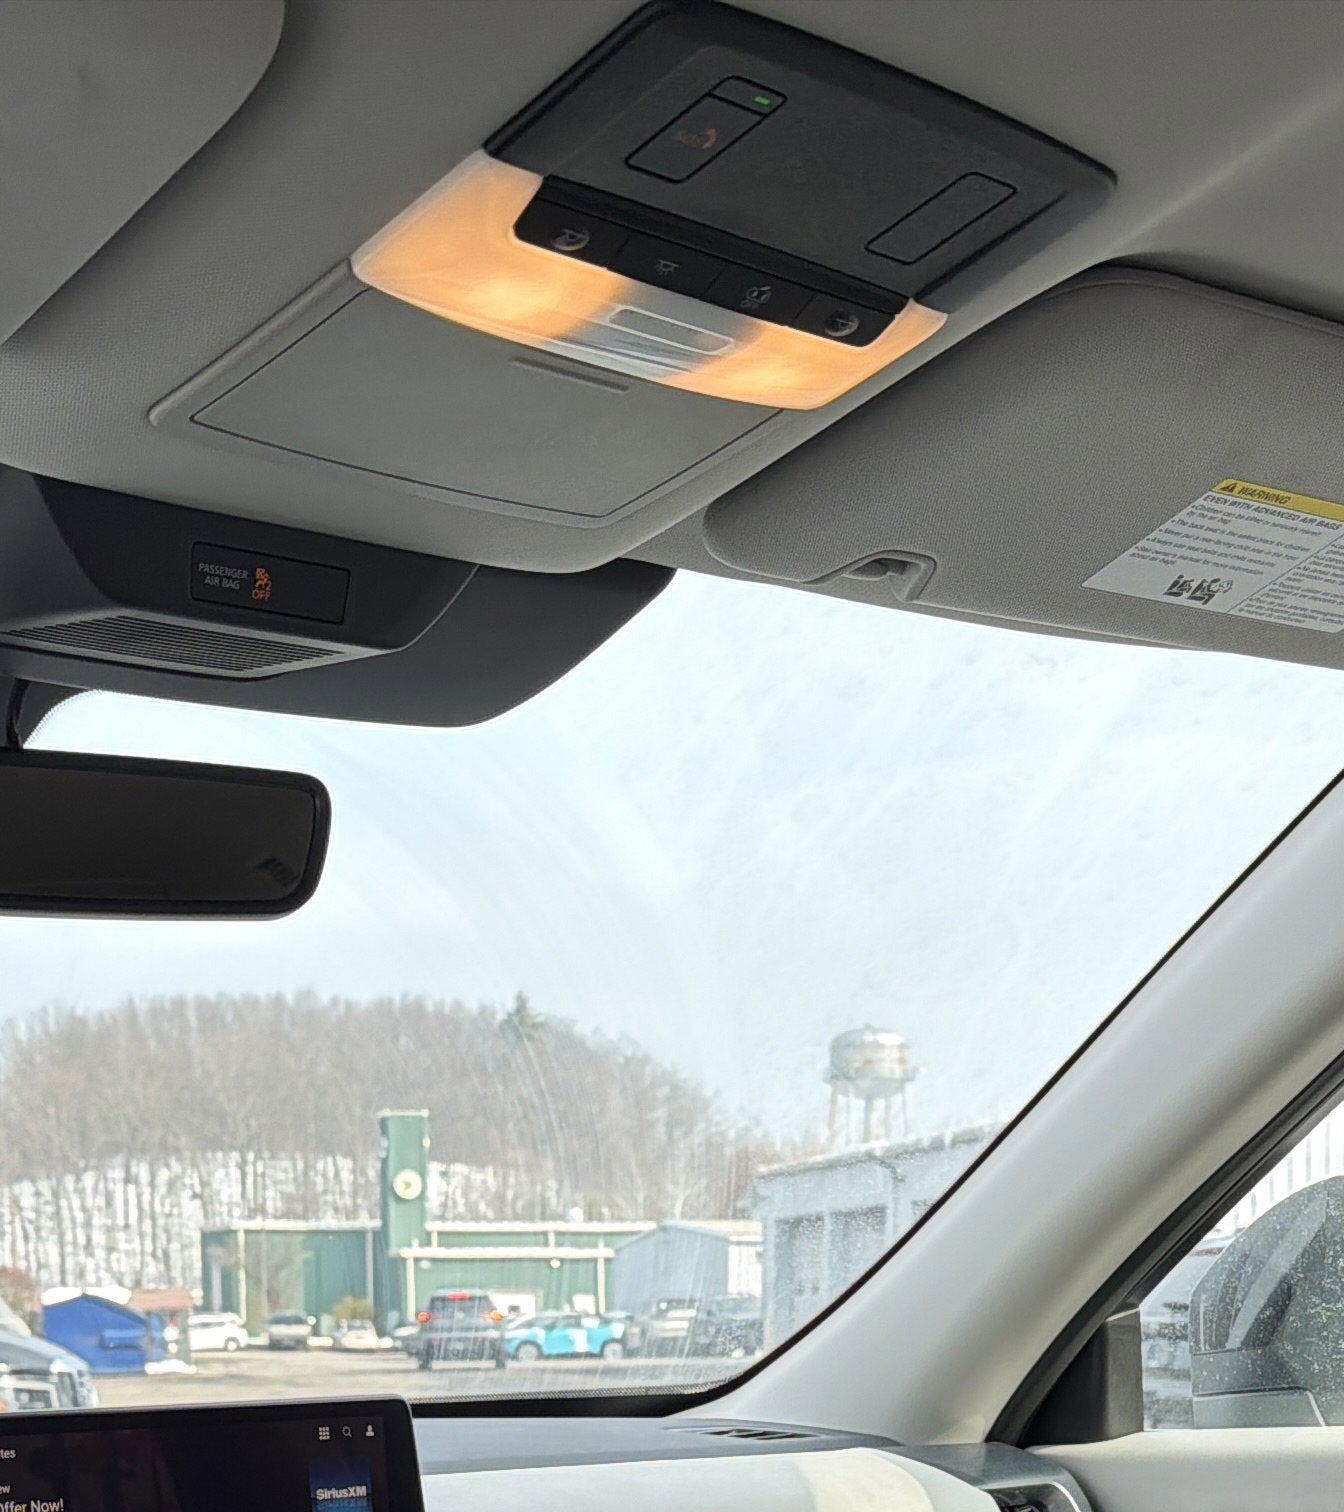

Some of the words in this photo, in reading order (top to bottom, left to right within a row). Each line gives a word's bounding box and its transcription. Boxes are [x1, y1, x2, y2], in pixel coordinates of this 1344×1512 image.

[1237, 487, 1291, 506] WARNING
[198, 562, 249, 580] PASSENGER
[204, 576, 221, 587] AIR
[222, 577, 241, 590] BAG
[251, 589, 271, 600] OFF
[316, 1485, 367, 1501] SiriusXM
